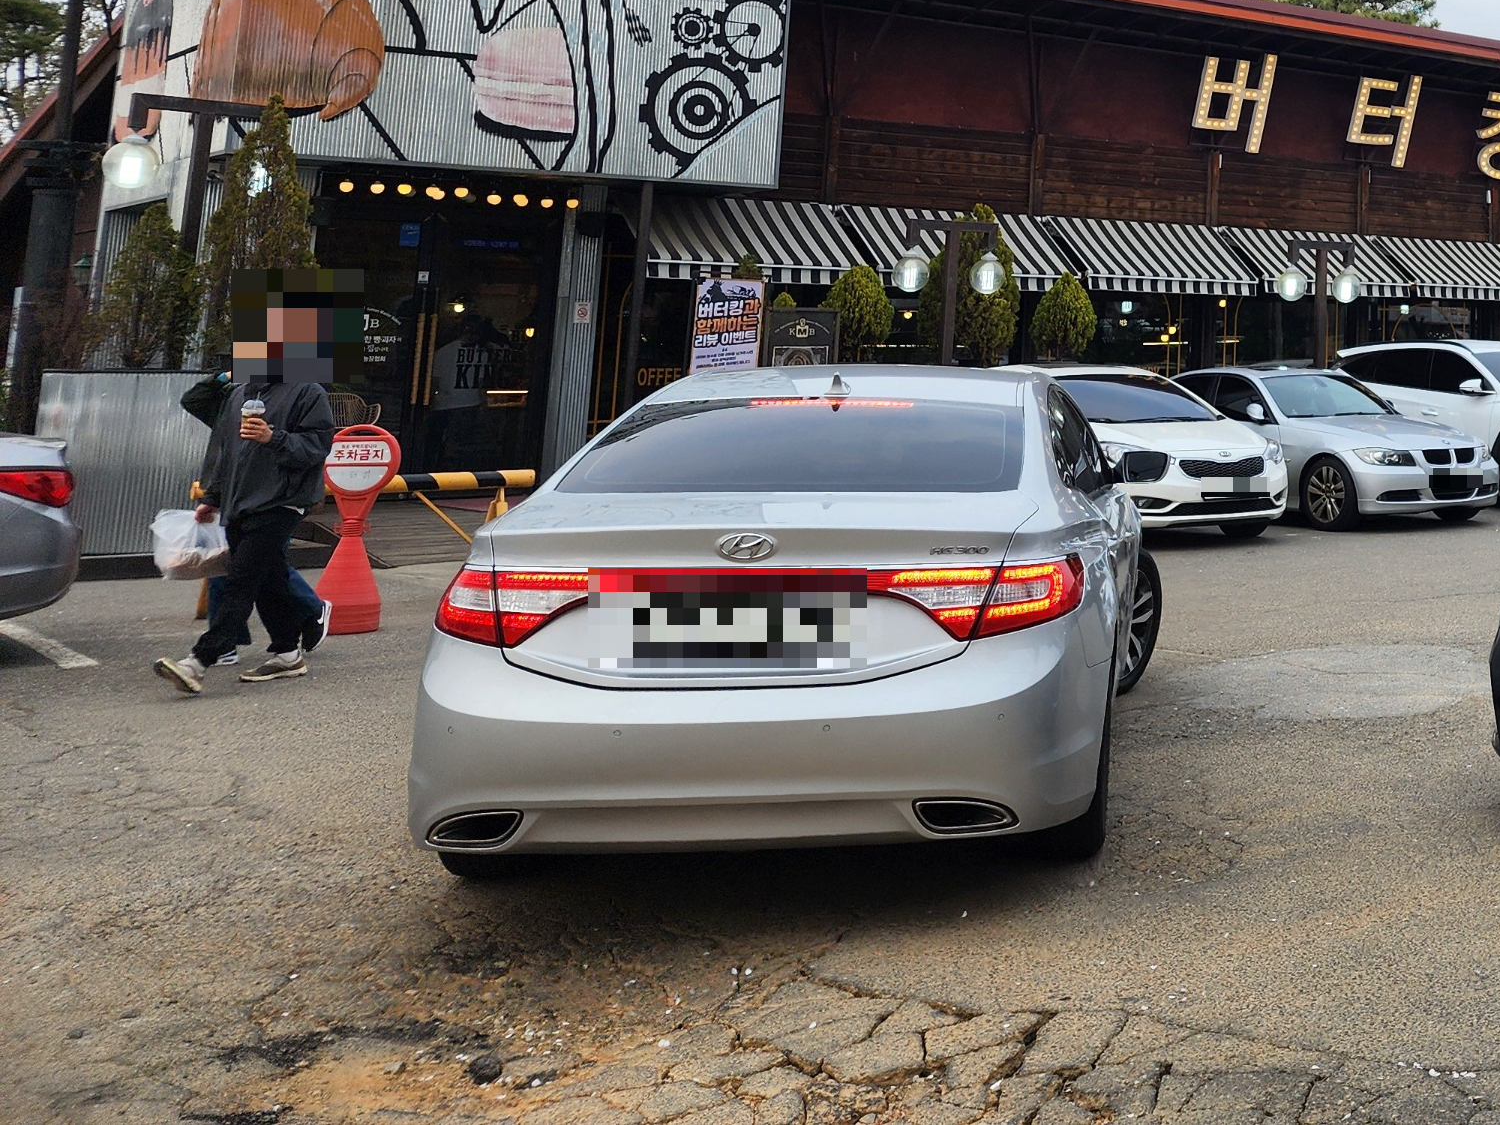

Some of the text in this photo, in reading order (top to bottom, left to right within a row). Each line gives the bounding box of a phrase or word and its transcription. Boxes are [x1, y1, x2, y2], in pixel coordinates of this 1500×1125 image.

[698, 298, 761, 318] 버터킹과
[696, 316, 759, 335] 함께하는
[694, 330, 757, 347] 리뷰 이벤트
[637, 367, 682, 386] OFFEE
[334, 448, 384, 461] 주차금지
